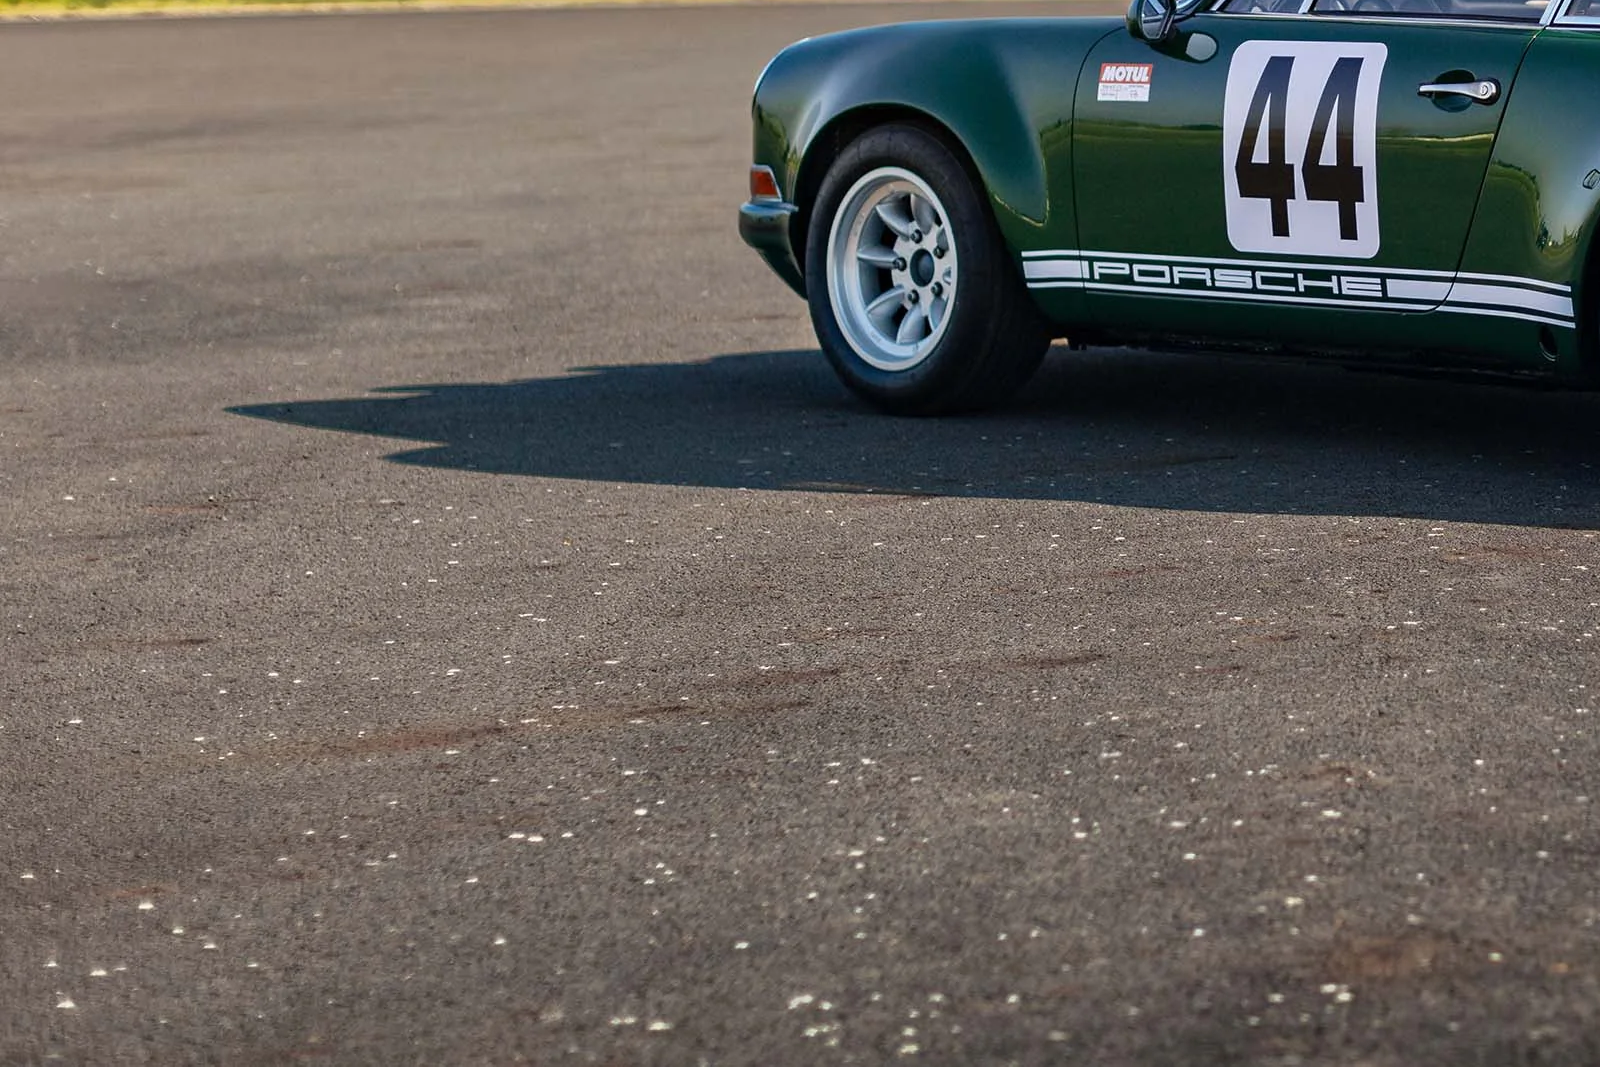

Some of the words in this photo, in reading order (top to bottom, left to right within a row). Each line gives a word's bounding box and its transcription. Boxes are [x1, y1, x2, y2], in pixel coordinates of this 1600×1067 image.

[1101, 66, 1149, 82] MOTUL
[1235, 56, 1364, 240] 44
[1094, 263, 1382, 297] PORSCHE
